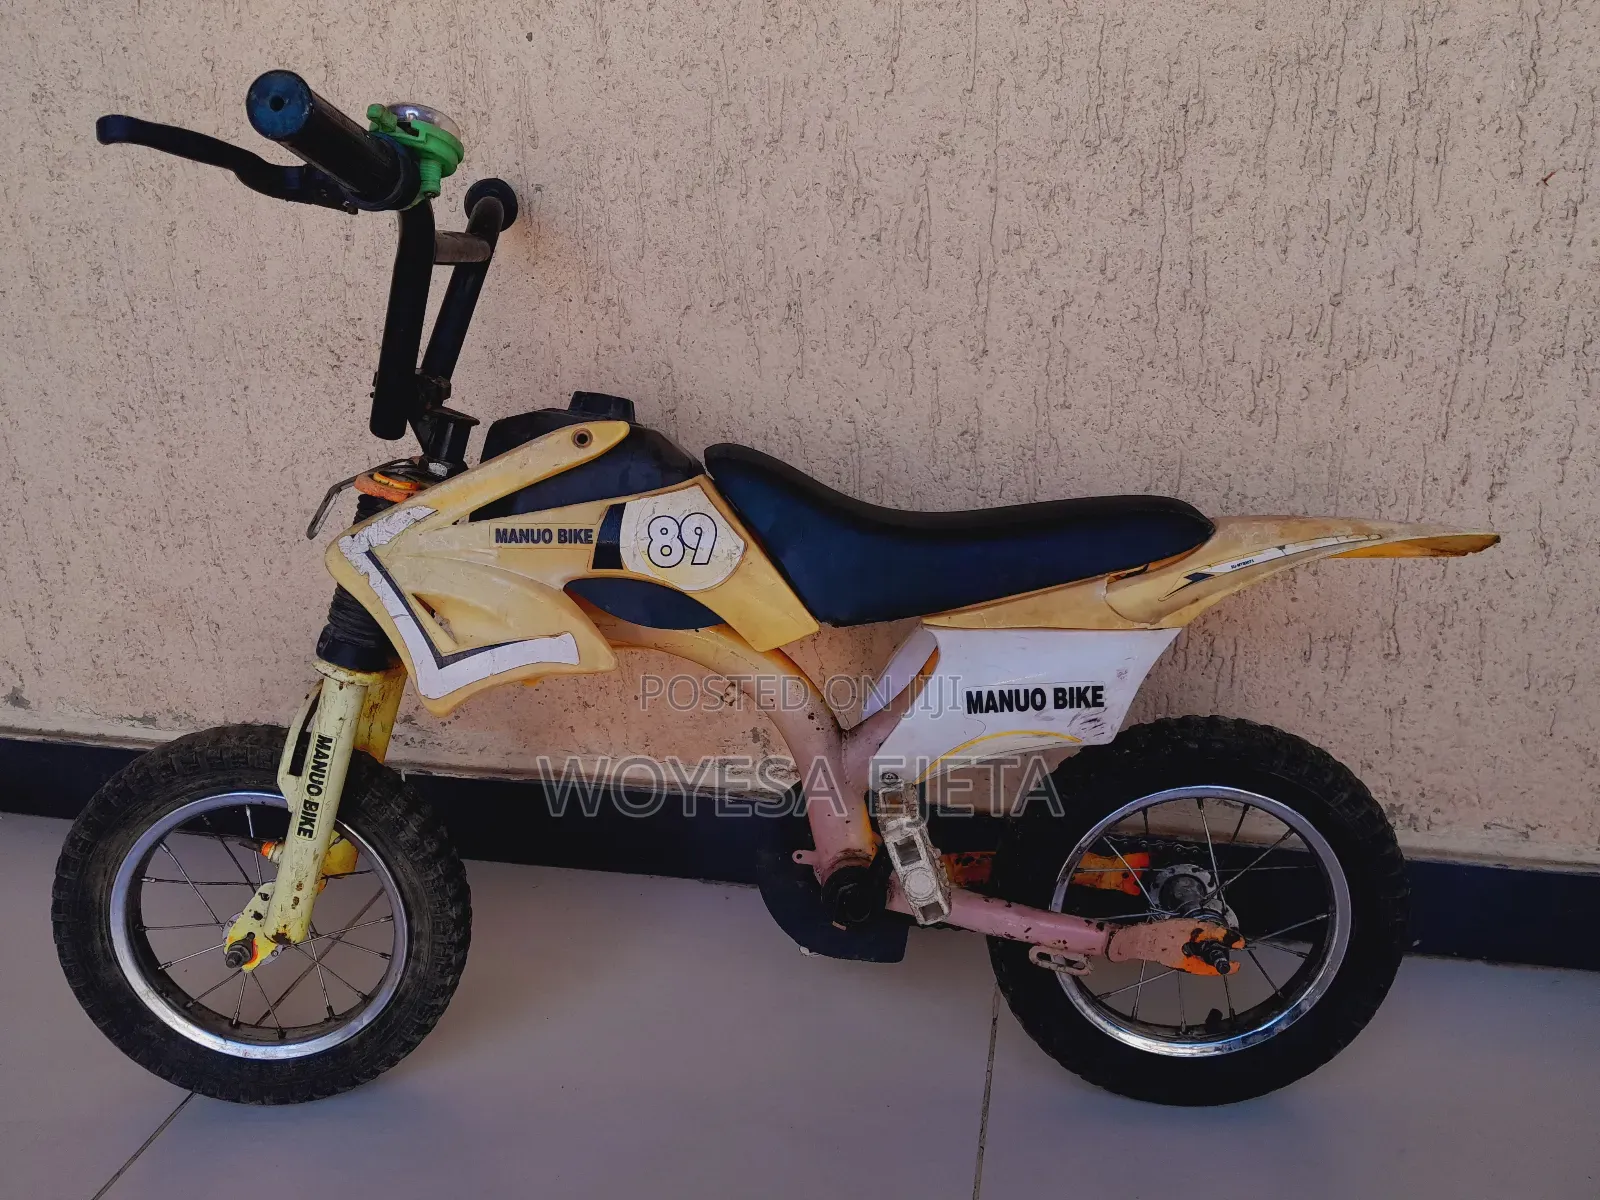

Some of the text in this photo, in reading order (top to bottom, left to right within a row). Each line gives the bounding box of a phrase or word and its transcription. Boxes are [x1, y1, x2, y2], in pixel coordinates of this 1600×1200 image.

[495, 528, 594, 545] MANUO BIKE
[647, 512, 718, 568] 89
[966, 685, 1105, 715] MANUO BIKE
[297, 734, 333, 839] MANUO BIKE
